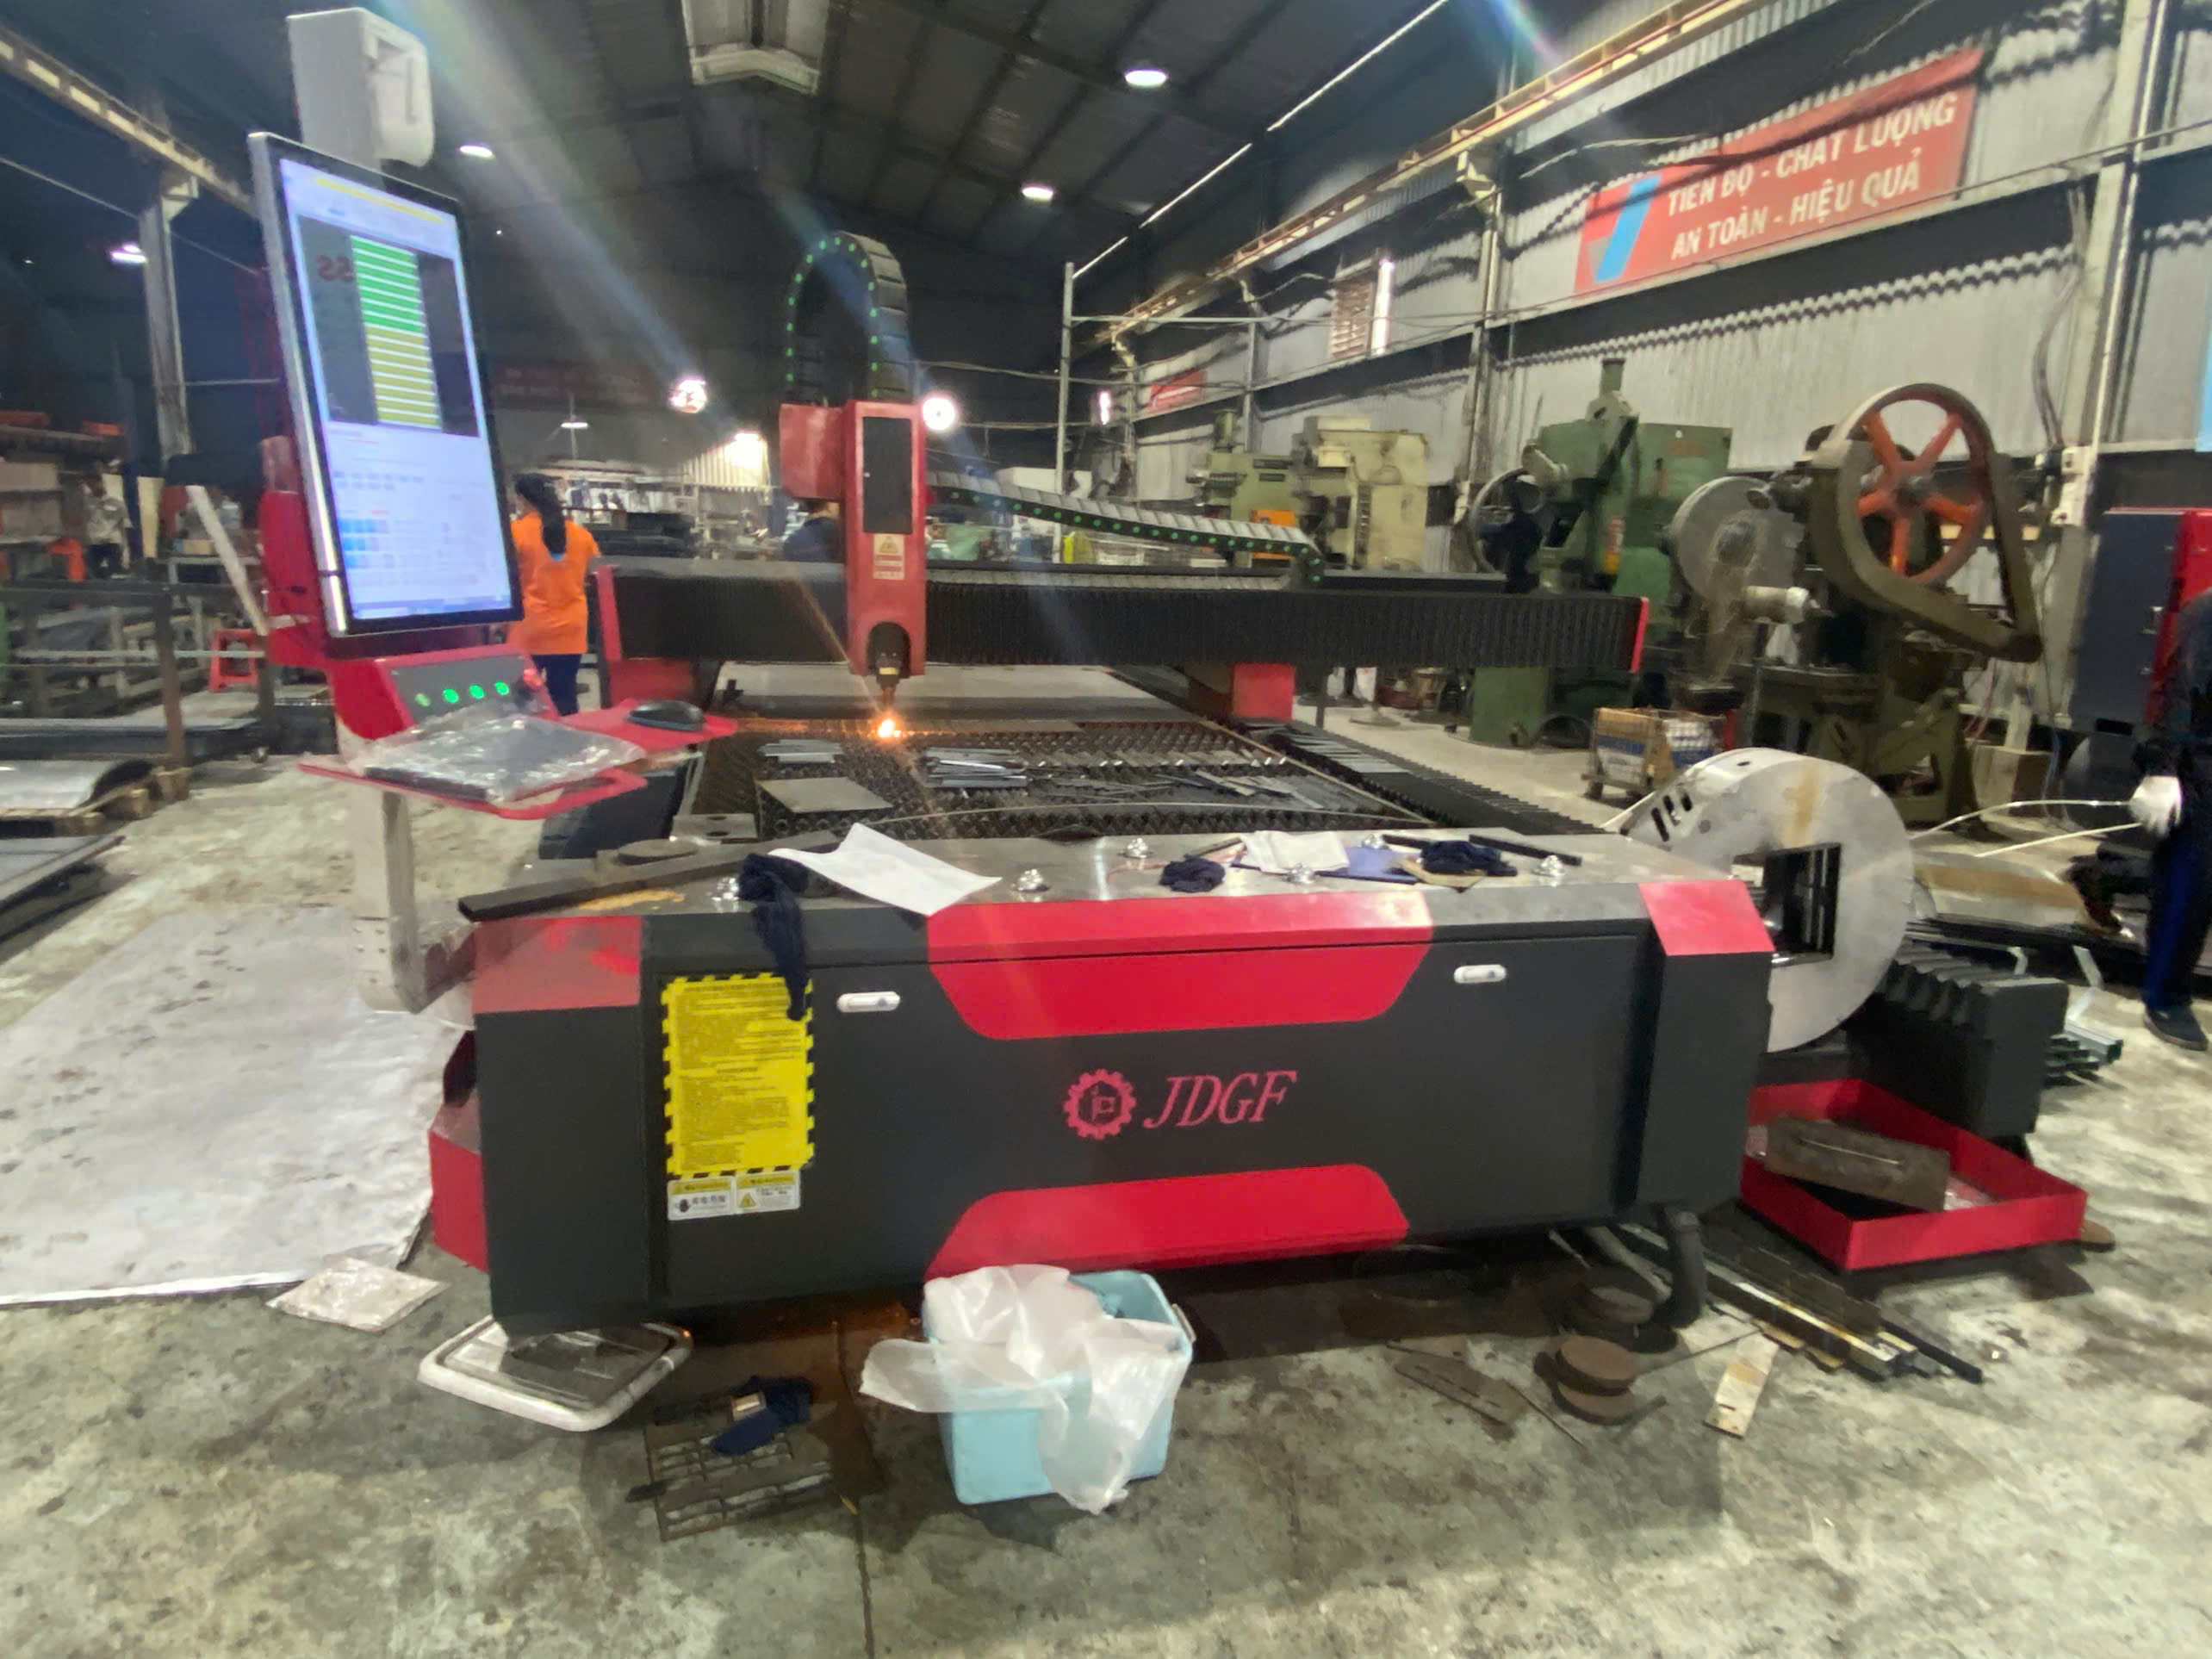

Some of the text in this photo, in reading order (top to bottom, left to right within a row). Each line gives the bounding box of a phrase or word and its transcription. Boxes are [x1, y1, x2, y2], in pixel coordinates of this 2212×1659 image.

[1671, 226, 1702, 260] AN
[1708, 206, 1768, 249] TOÀN
[1789, 178, 1855, 227] HIỆU
[1143, 1071, 1297, 1129] JDGF
